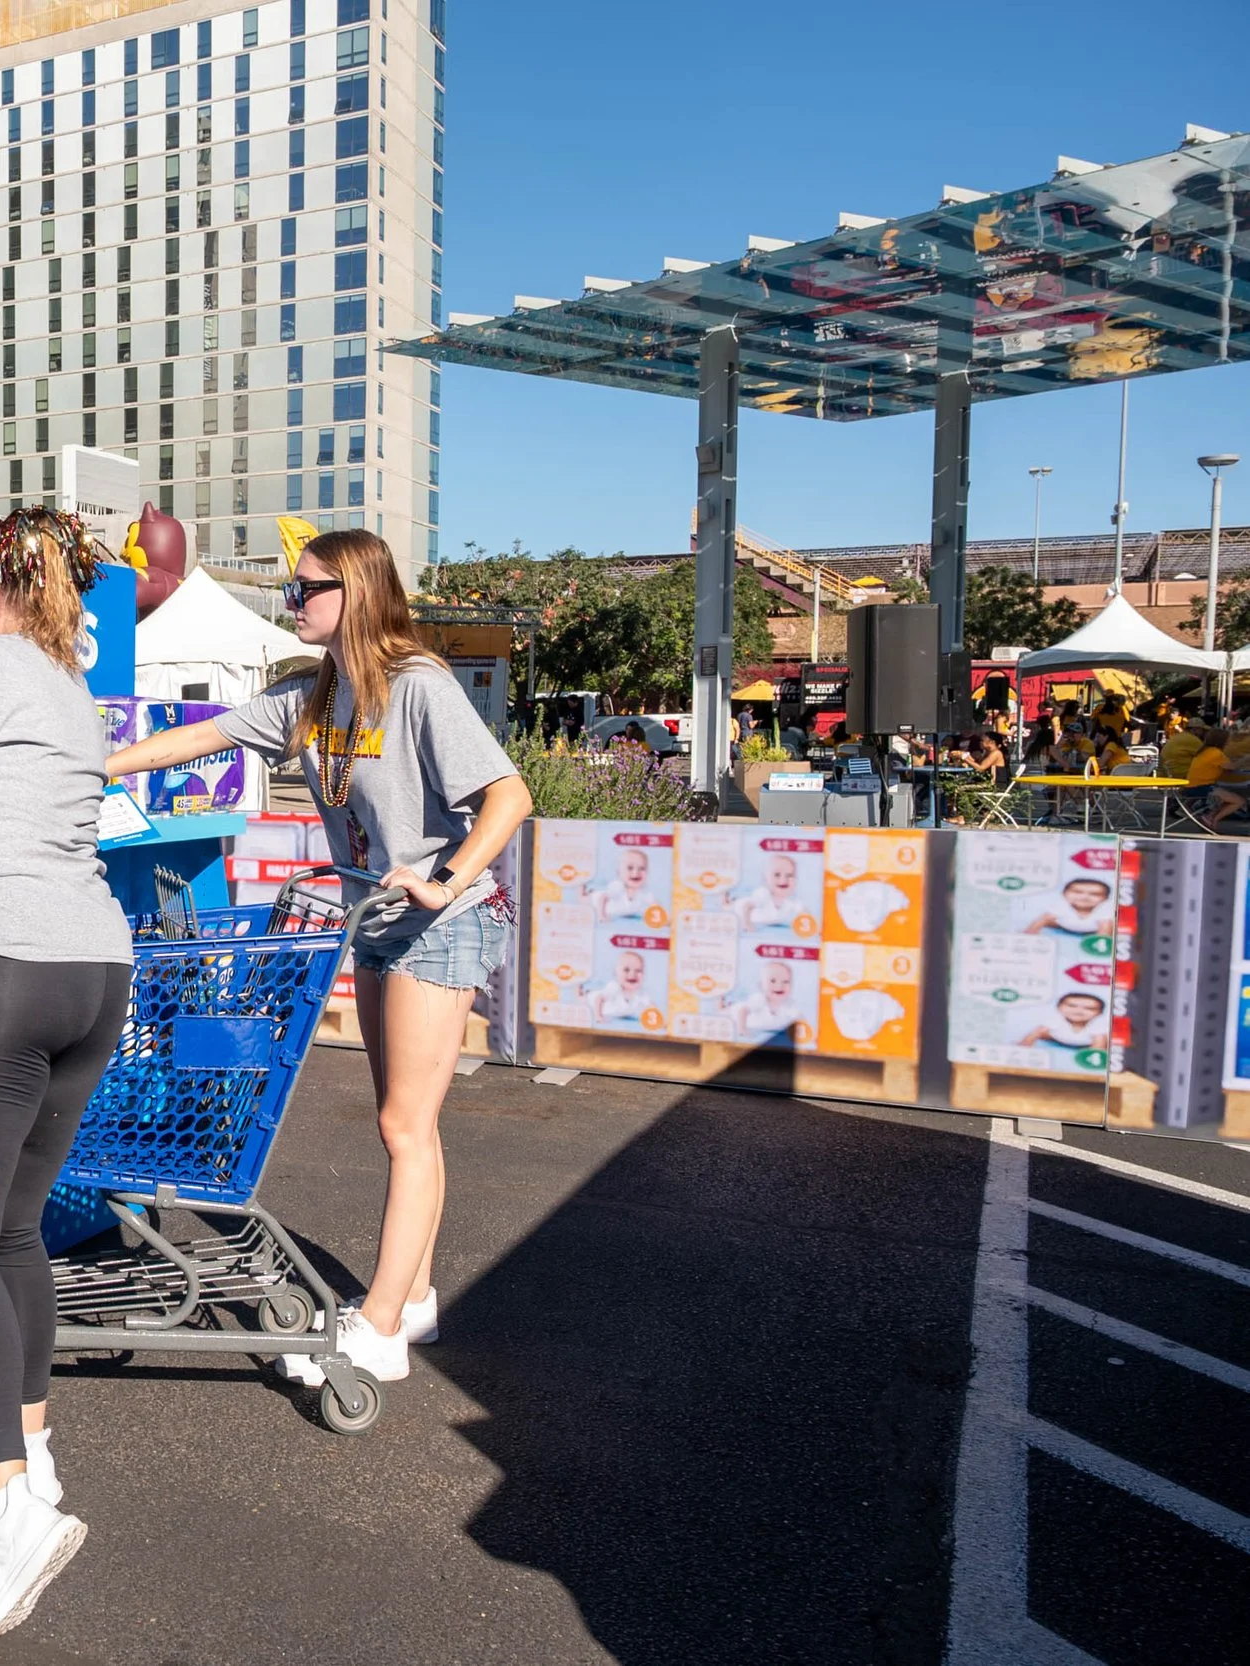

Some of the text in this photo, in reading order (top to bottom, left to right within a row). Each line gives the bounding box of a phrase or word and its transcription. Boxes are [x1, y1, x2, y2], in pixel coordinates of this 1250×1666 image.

[651, 910, 661, 923] 3
[800, 918, 810, 932] 3
[646, 1012, 658, 1026] 3
